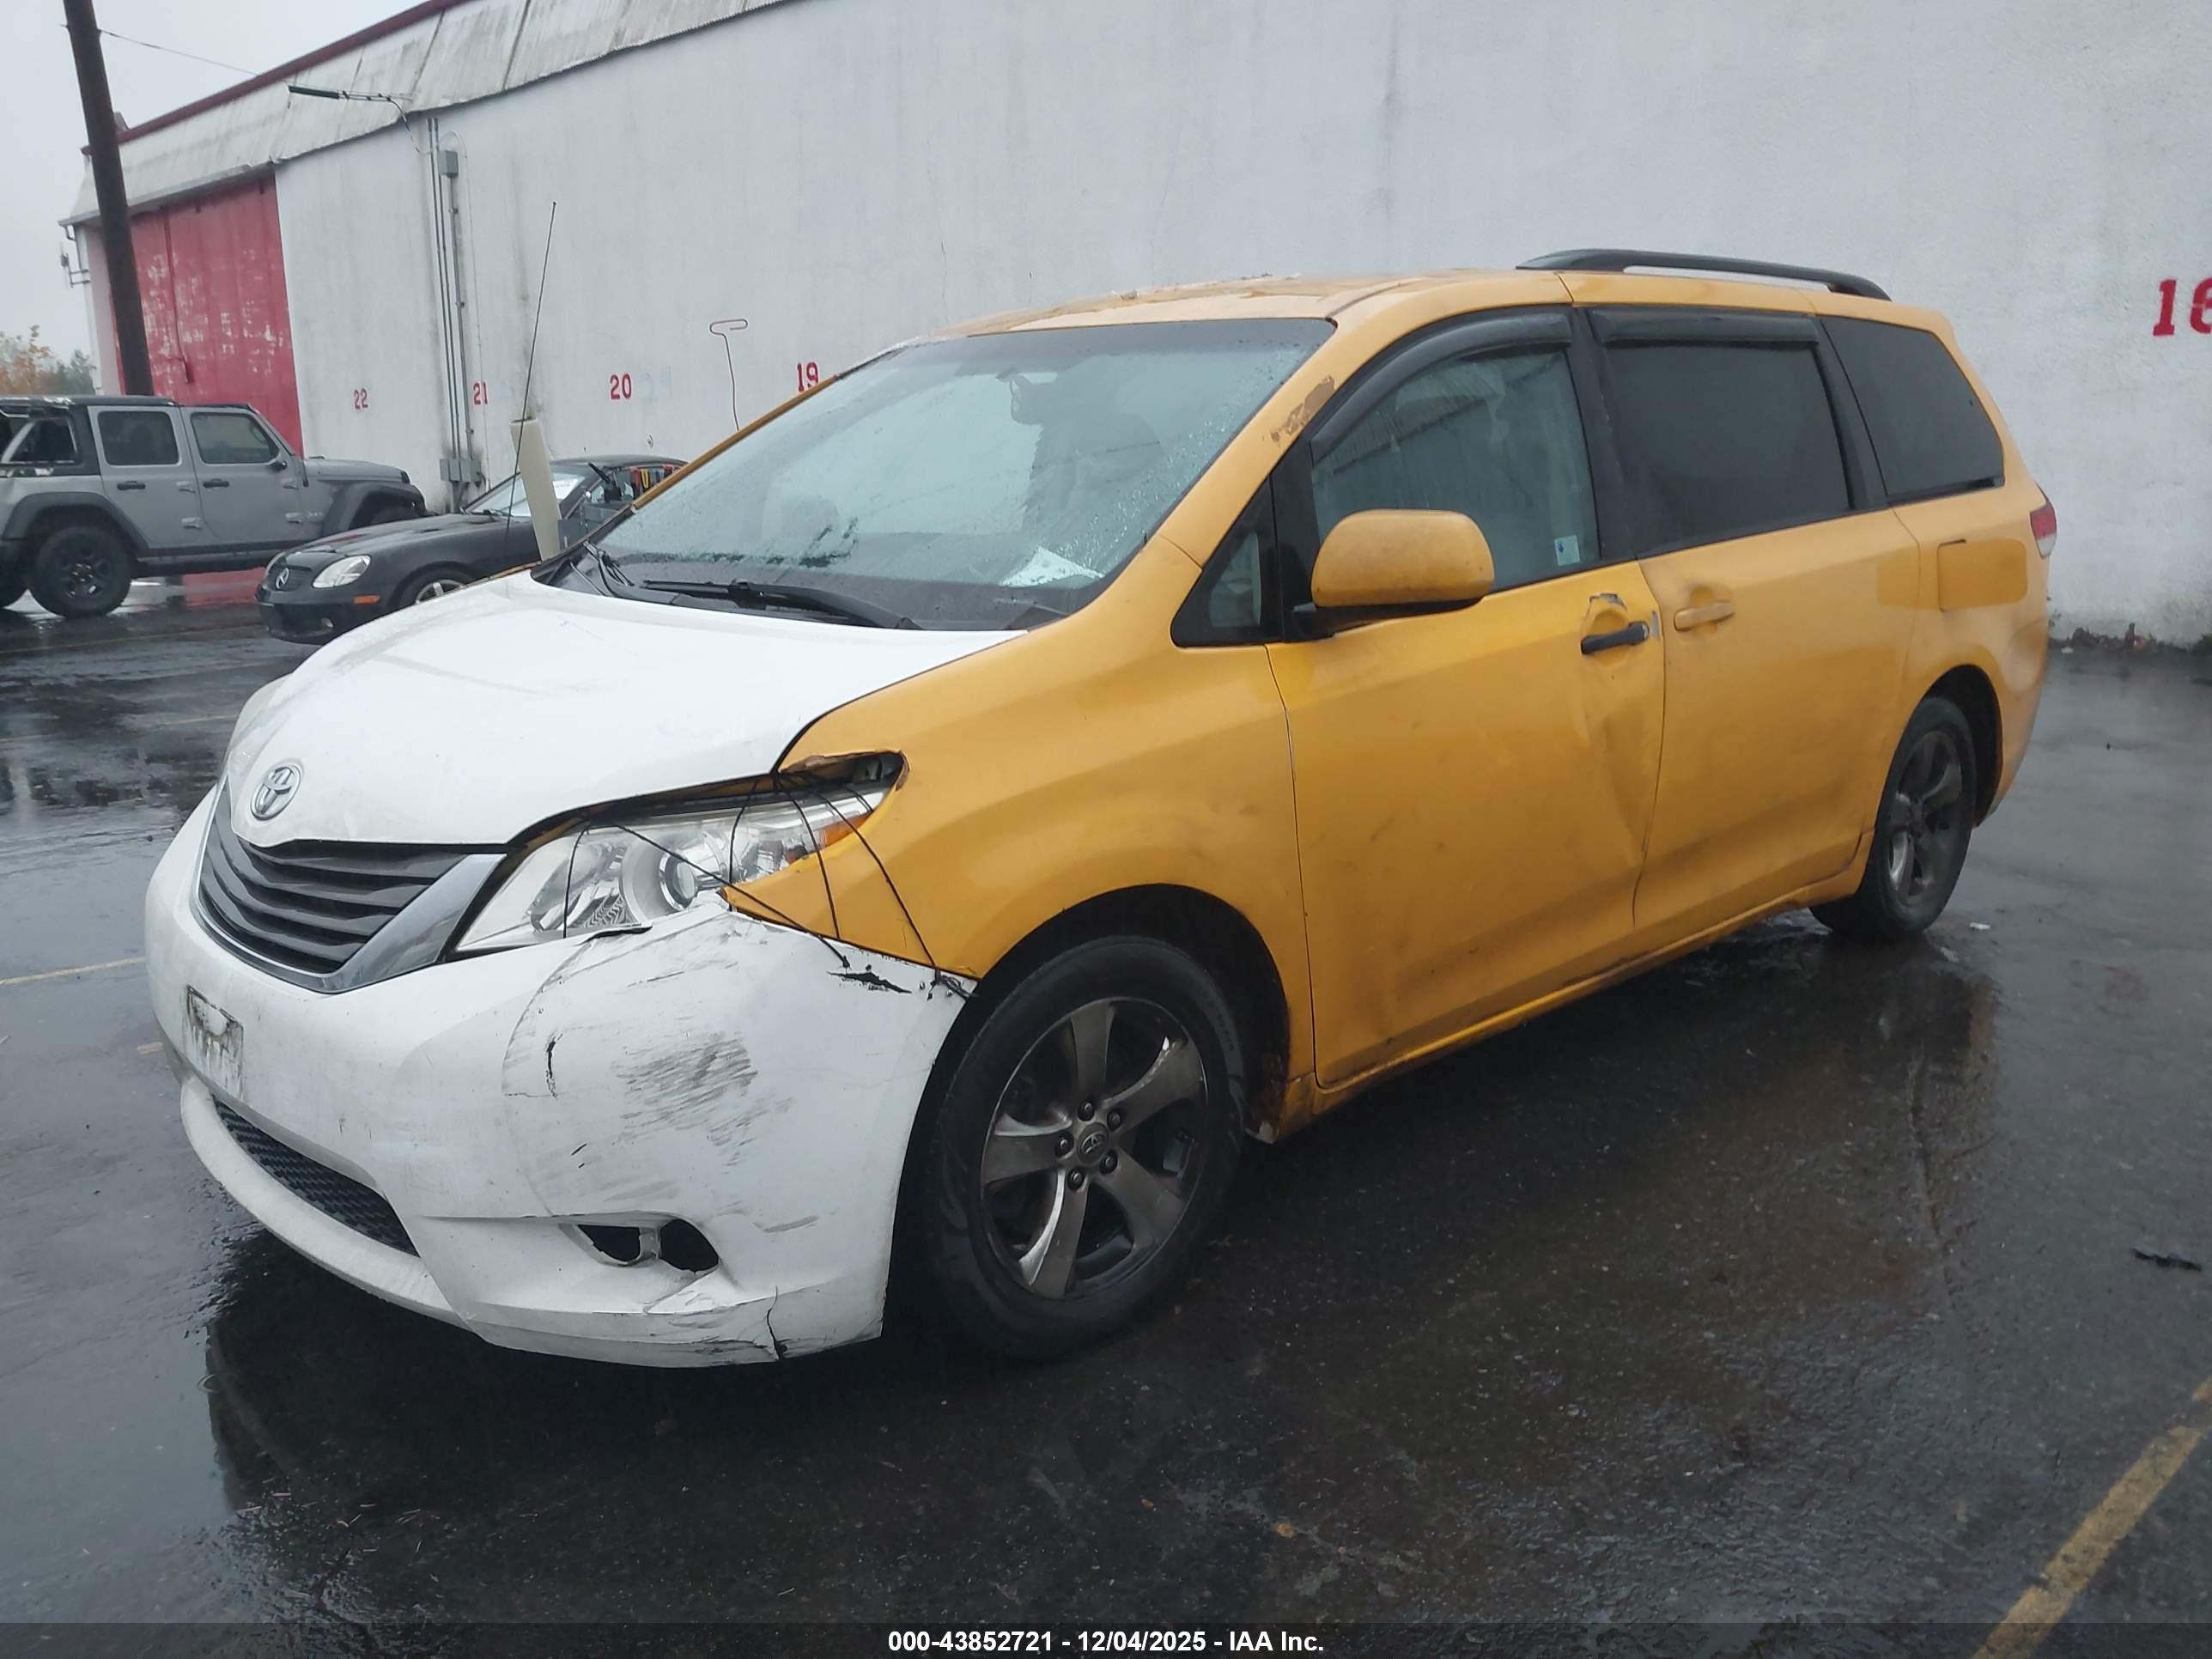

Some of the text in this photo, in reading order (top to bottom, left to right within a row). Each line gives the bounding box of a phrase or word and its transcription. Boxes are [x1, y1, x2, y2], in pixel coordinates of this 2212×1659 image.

[610, 373, 632, 400] 20
[797, 362, 818, 392] 19
[353, 387, 368, 410] 22
[472, 381, 489, 405] 21
